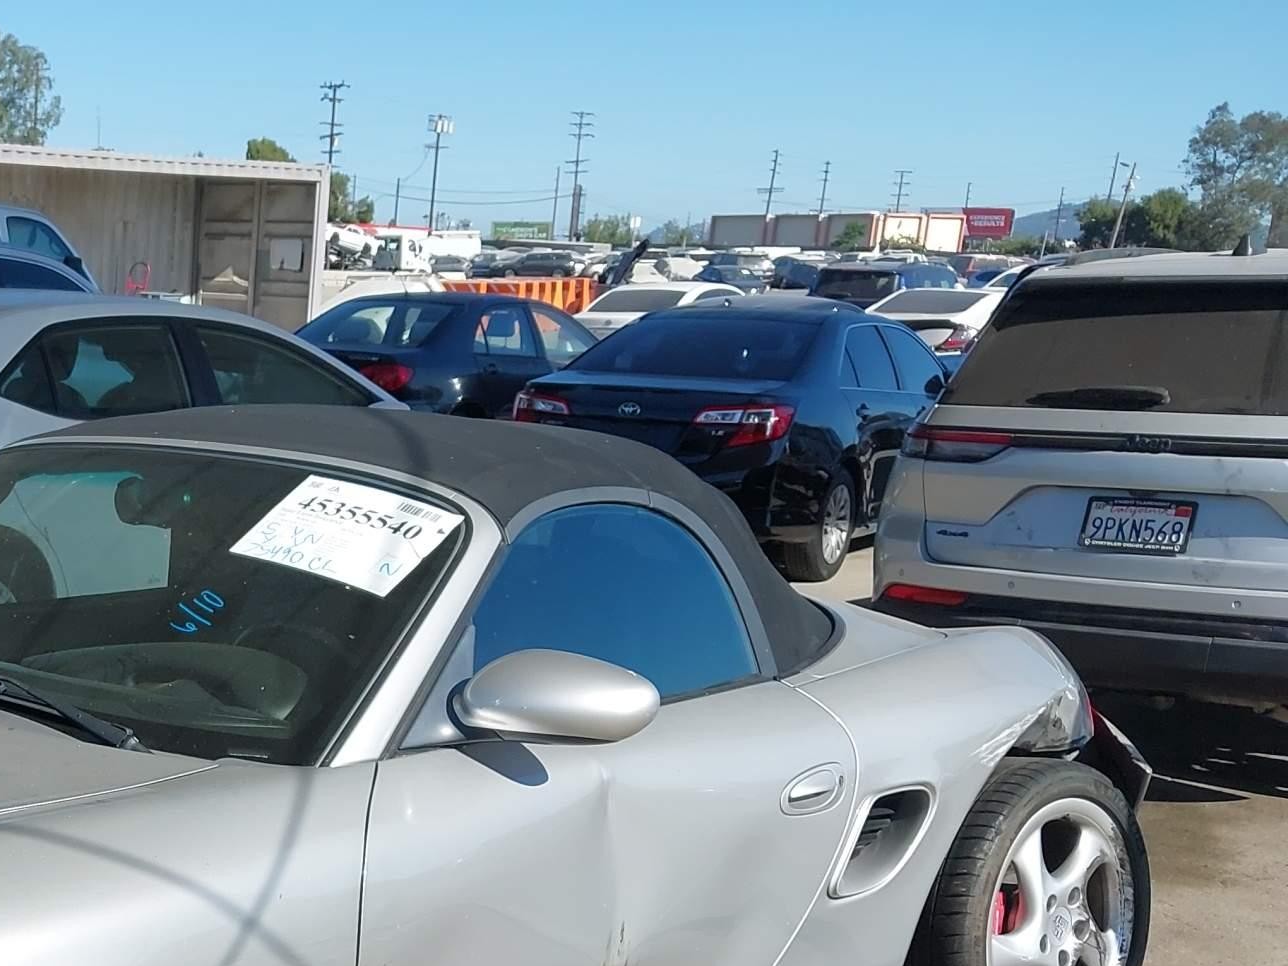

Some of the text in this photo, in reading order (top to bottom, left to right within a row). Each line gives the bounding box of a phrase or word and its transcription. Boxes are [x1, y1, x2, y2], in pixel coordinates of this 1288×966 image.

[297, 496, 423, 540] 45355540
[1089, 515, 1185, 545] 9PKN568
[168, 590, 225, 632] 6/10
